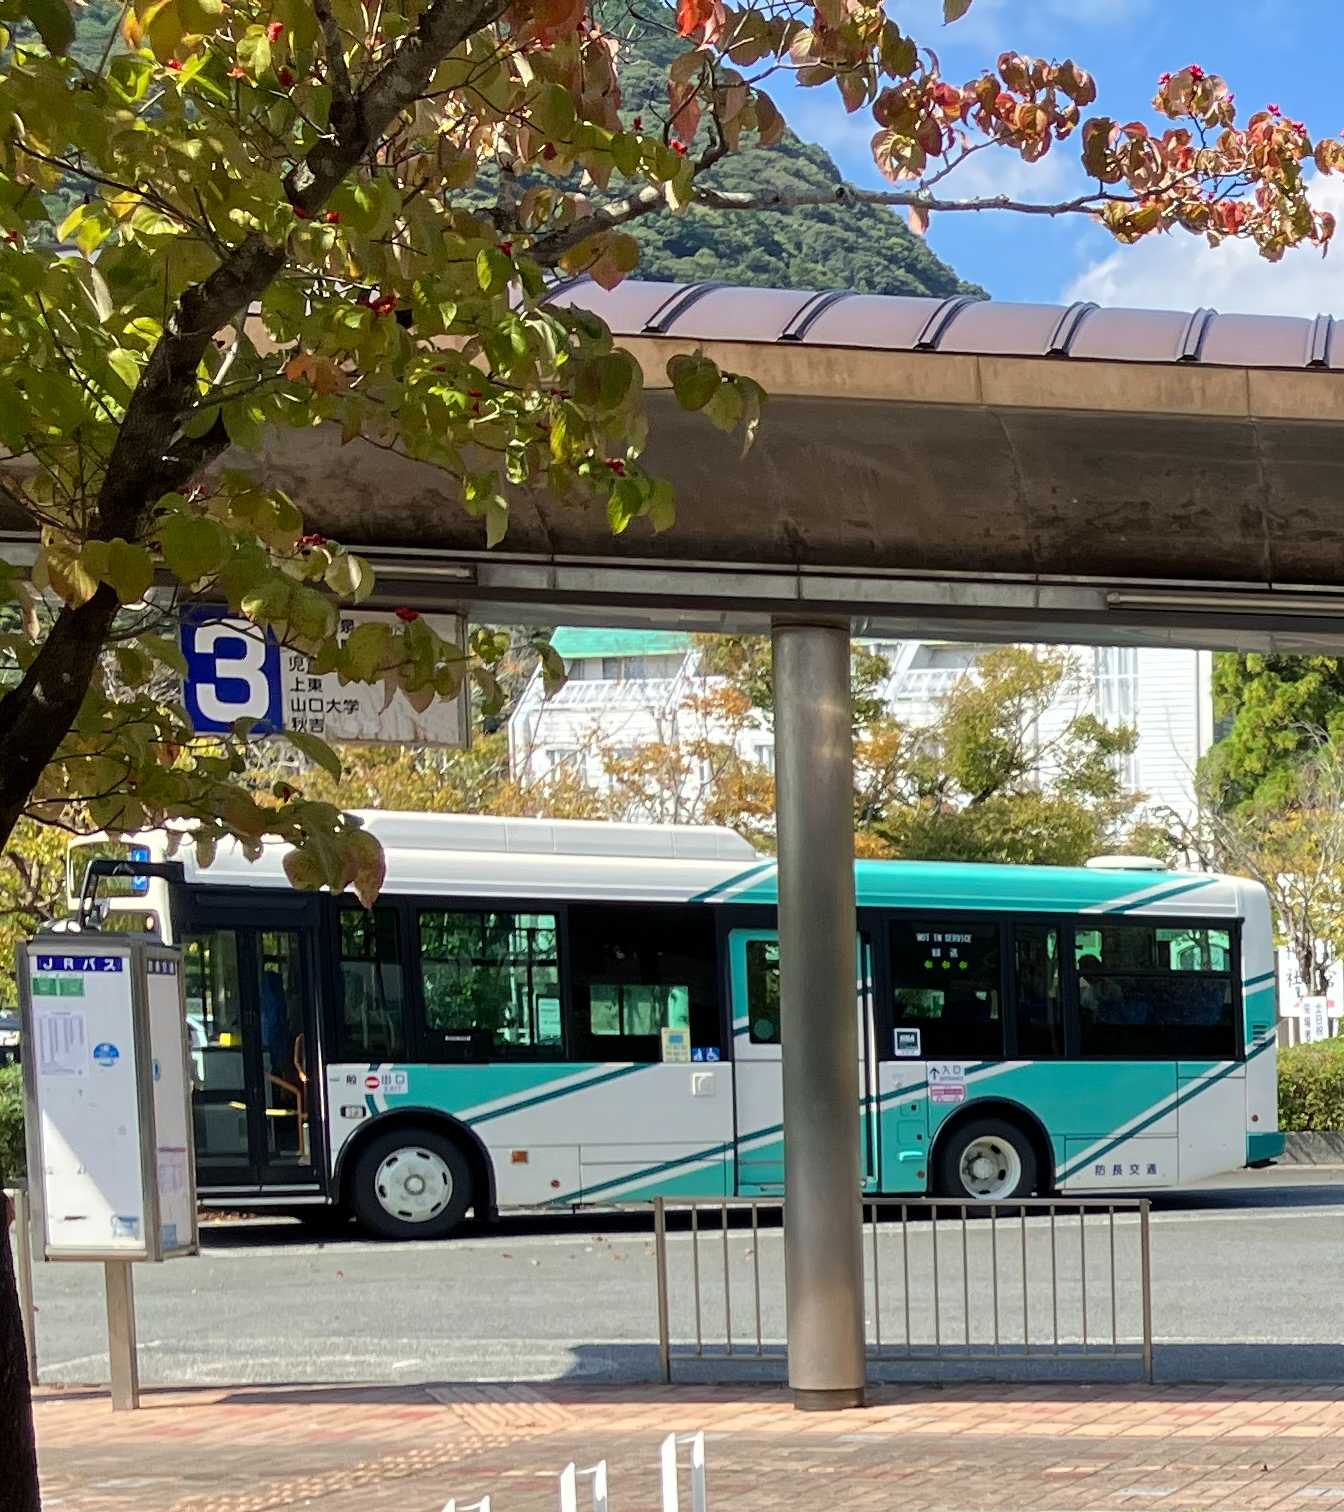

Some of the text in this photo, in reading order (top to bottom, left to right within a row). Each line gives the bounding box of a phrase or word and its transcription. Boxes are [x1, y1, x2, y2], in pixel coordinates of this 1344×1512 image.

[195, 619, 268, 722] 3
[290, 677, 322, 693] 上東
[291, 700, 360, 715] 山口大学
[291, 718, 324, 734] 秋吉
